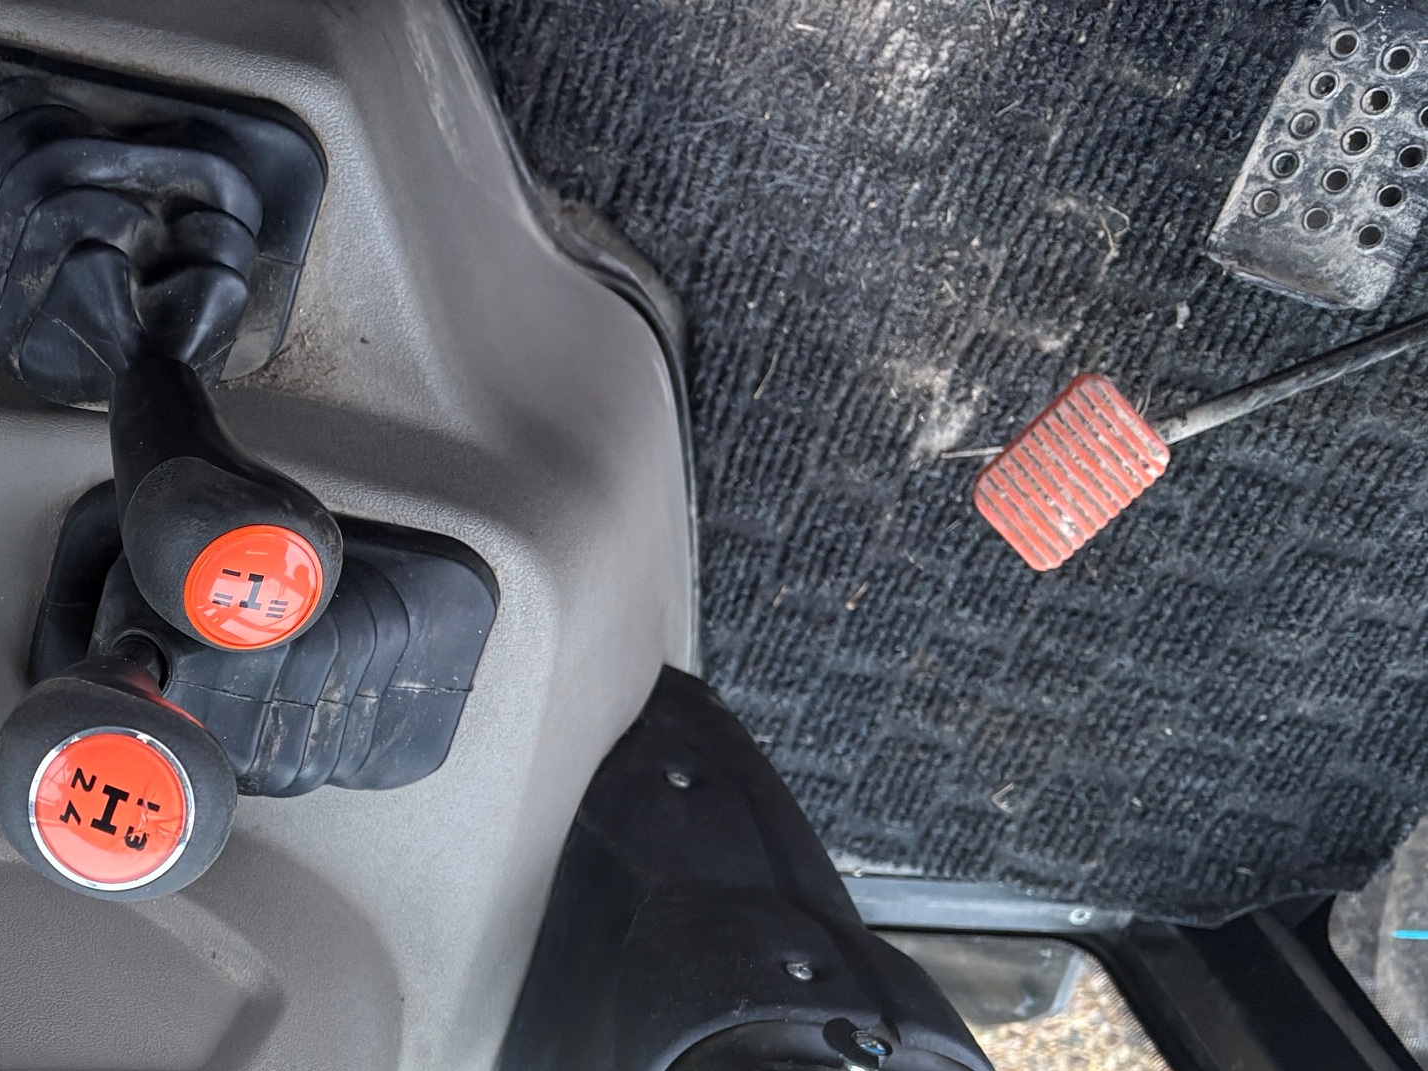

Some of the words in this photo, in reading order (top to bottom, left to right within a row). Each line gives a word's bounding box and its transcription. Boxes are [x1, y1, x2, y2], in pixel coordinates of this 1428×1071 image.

[70, 767, 97, 792] 2
[59, 800, 82, 826] 4
[124, 826, 150, 851] 3
